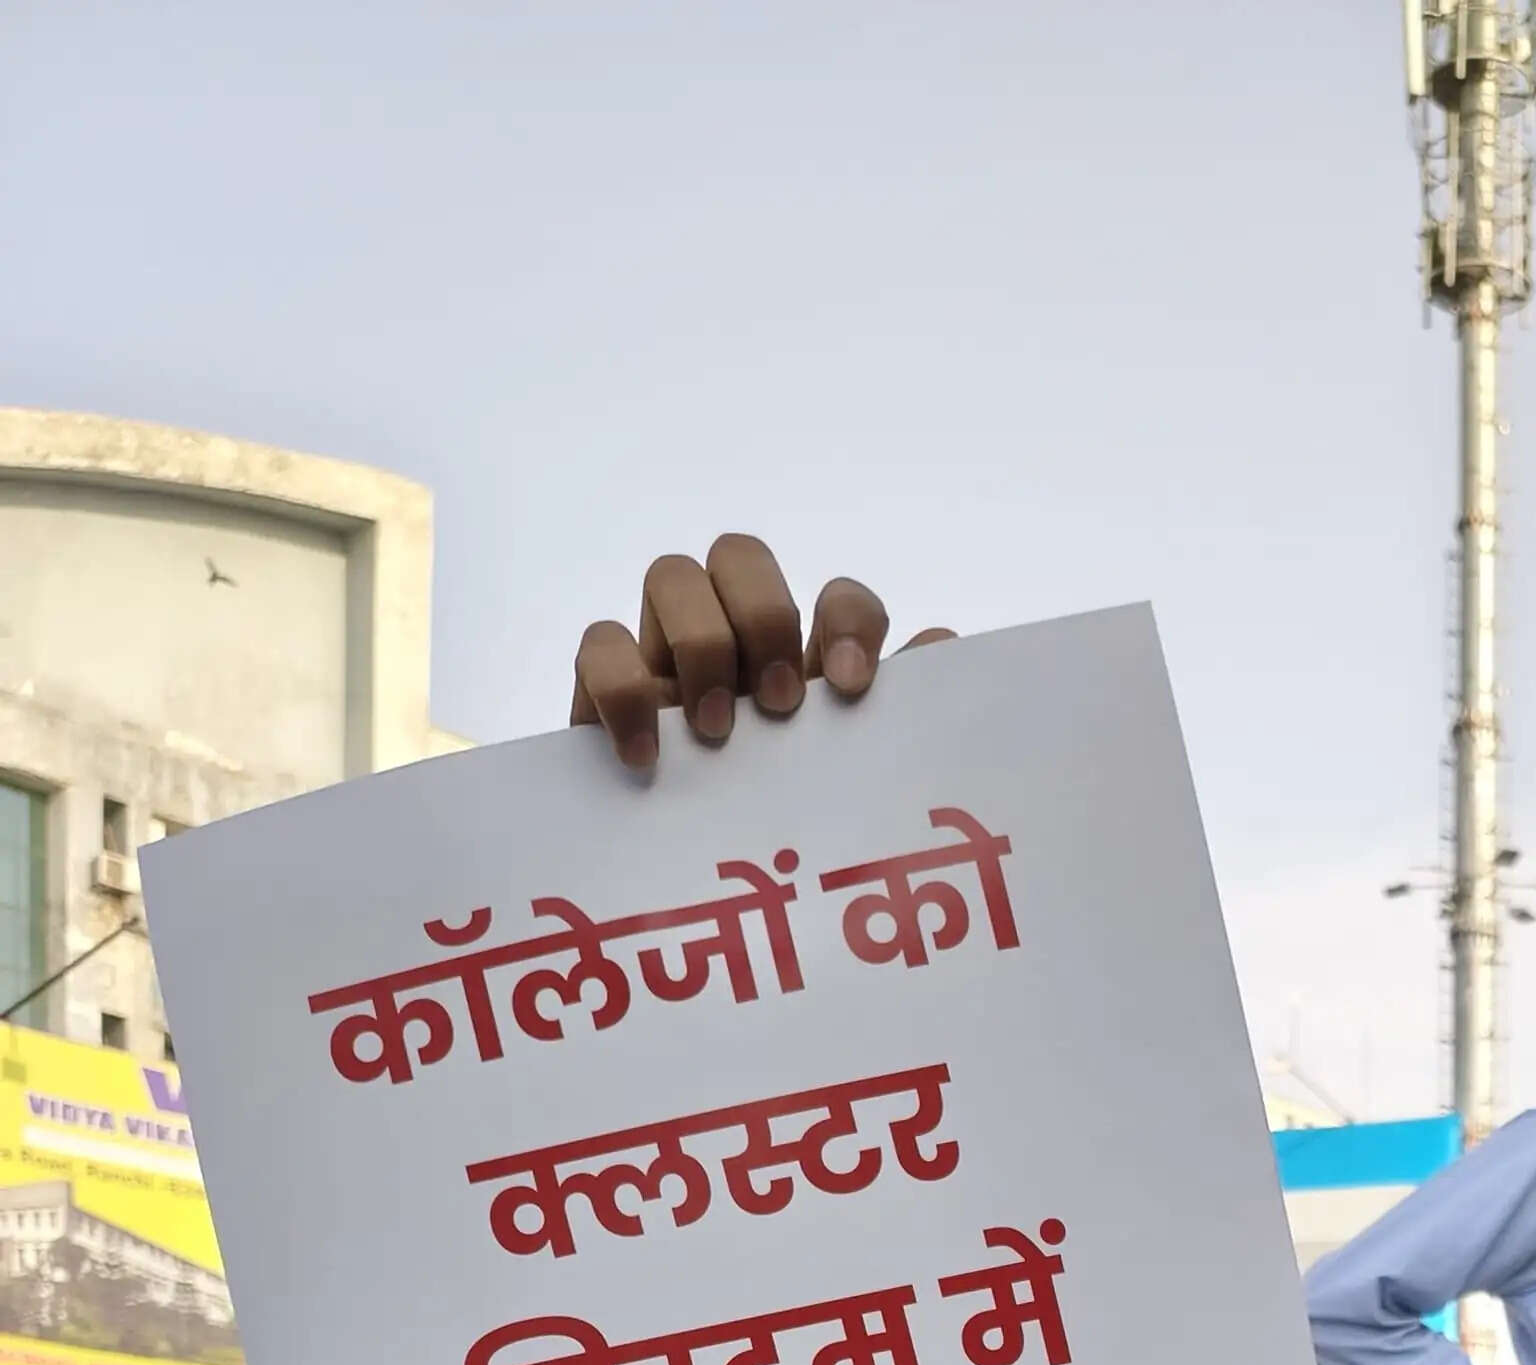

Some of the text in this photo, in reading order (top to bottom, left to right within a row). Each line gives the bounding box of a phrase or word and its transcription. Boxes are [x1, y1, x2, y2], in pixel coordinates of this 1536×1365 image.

[307, 806, 1021, 1084] कॉलेजों को
[465, 1062, 960, 1258] क्लस्टर
